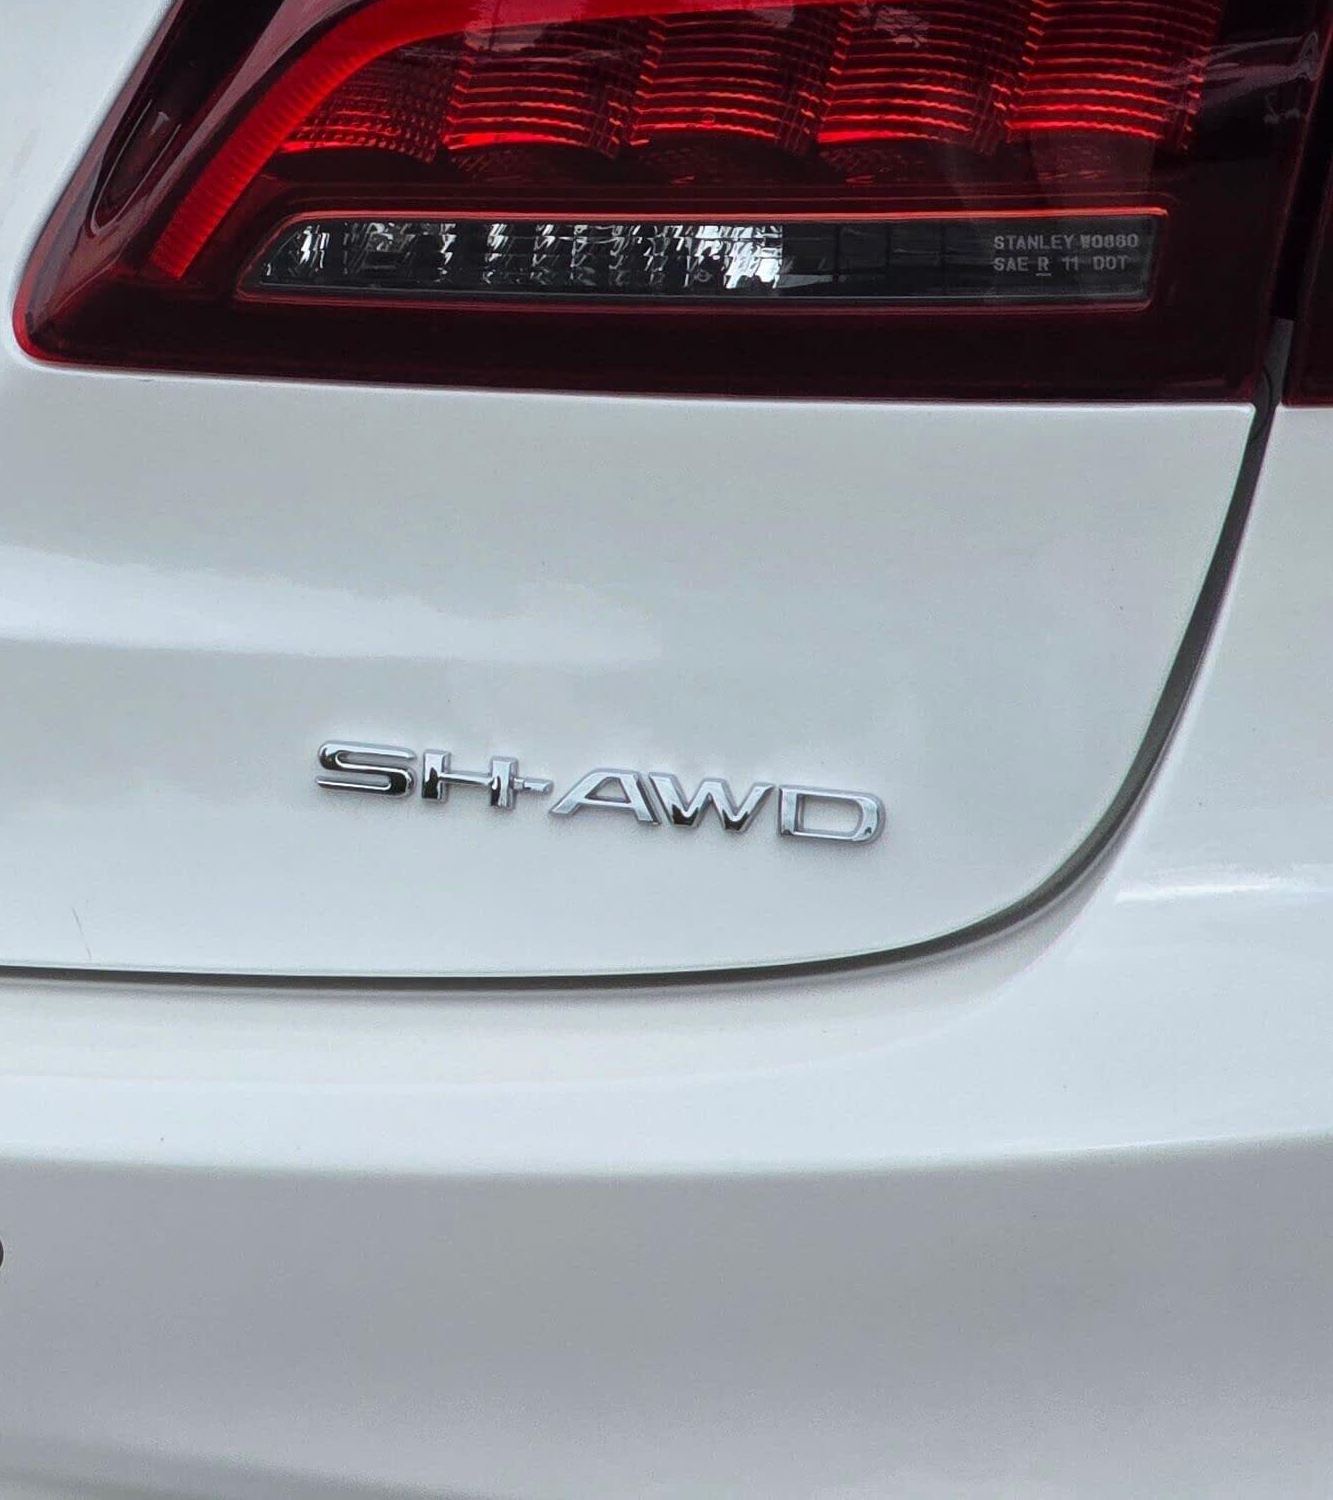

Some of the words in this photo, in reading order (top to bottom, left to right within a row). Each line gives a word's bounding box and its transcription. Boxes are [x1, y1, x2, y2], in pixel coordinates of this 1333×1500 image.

[993, 234, 1074, 250] STANLEY
[993, 257, 1028, 272] SAE
[1094, 255, 1127, 270] DOT
[315, 739, 887, 843] SH-AWD
